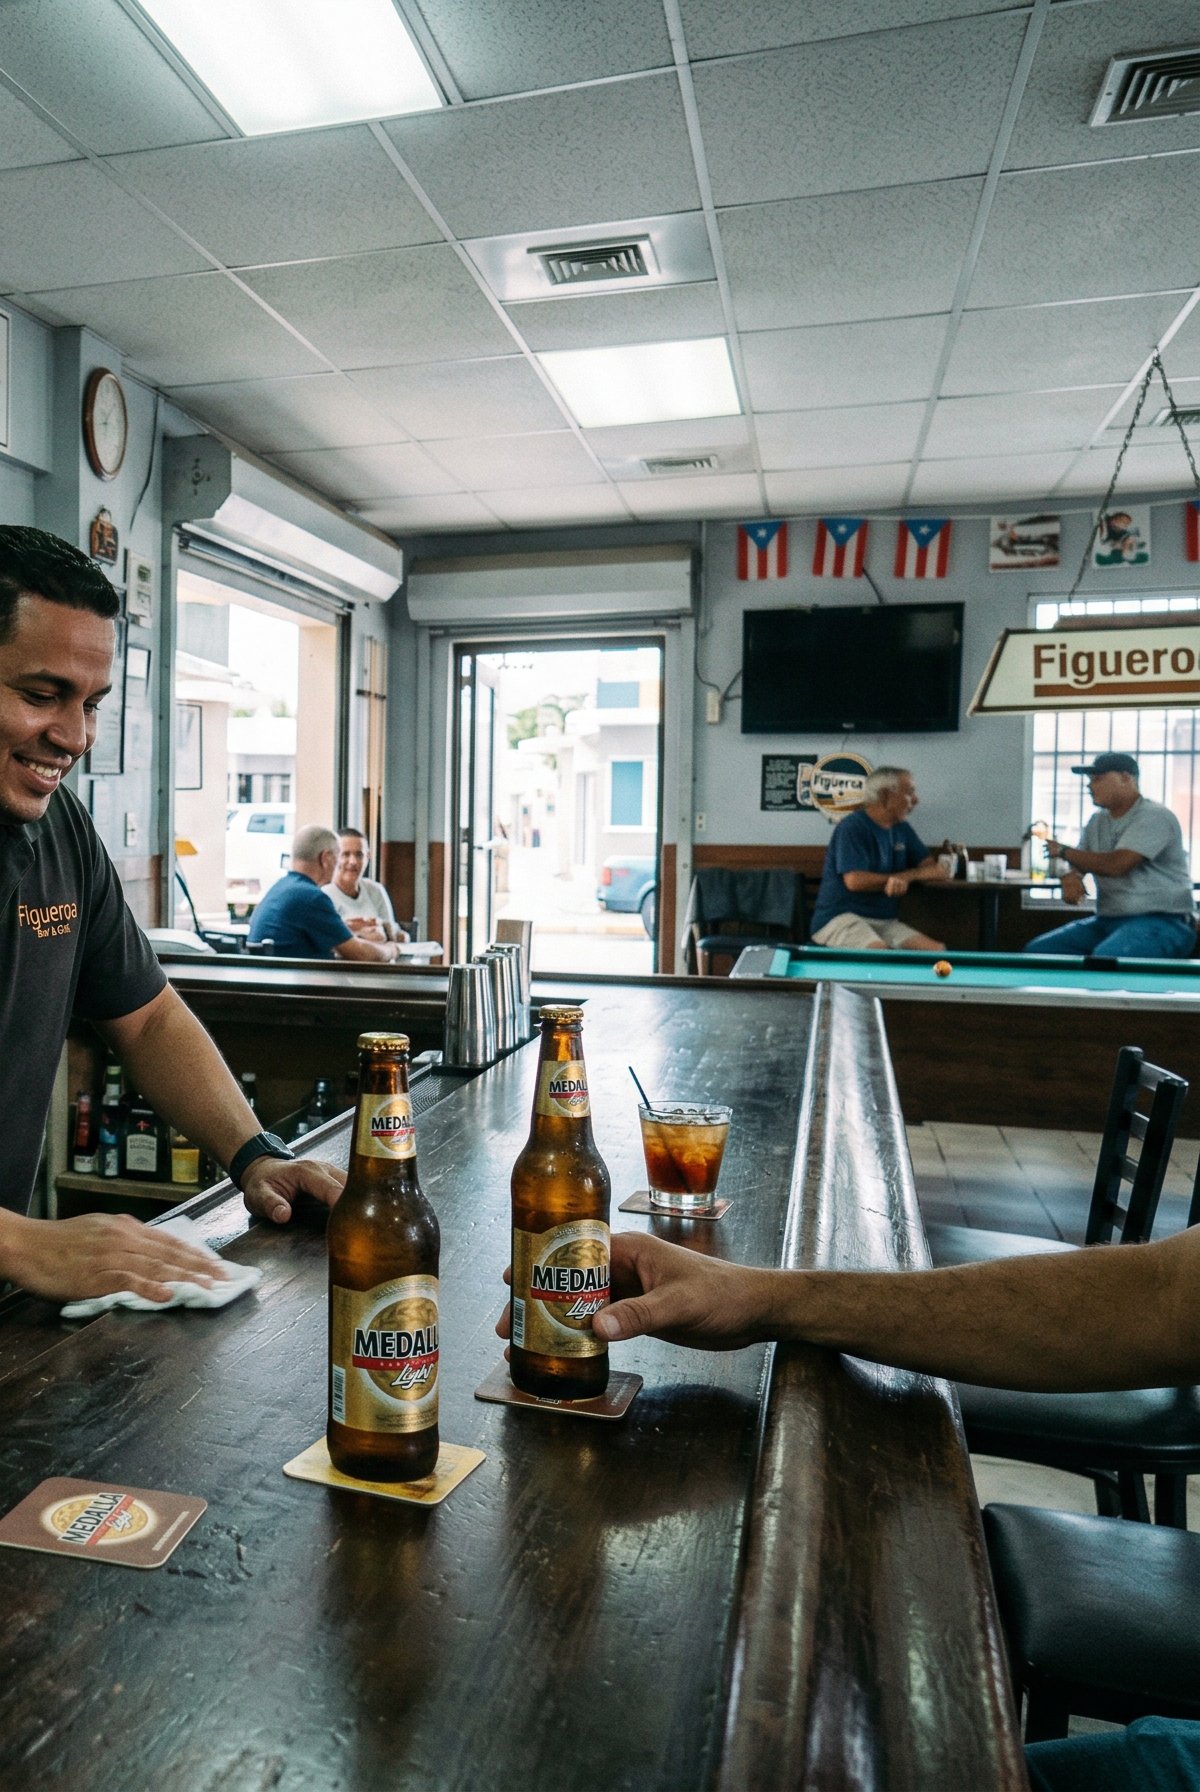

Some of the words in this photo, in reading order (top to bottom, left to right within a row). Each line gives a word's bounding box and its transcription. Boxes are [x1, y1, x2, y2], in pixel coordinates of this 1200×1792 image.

[1033, 643, 1200, 685] Figuero
[17, 902, 78, 931] Figueroa
[60, 1492, 125, 1544] MEDALLA
